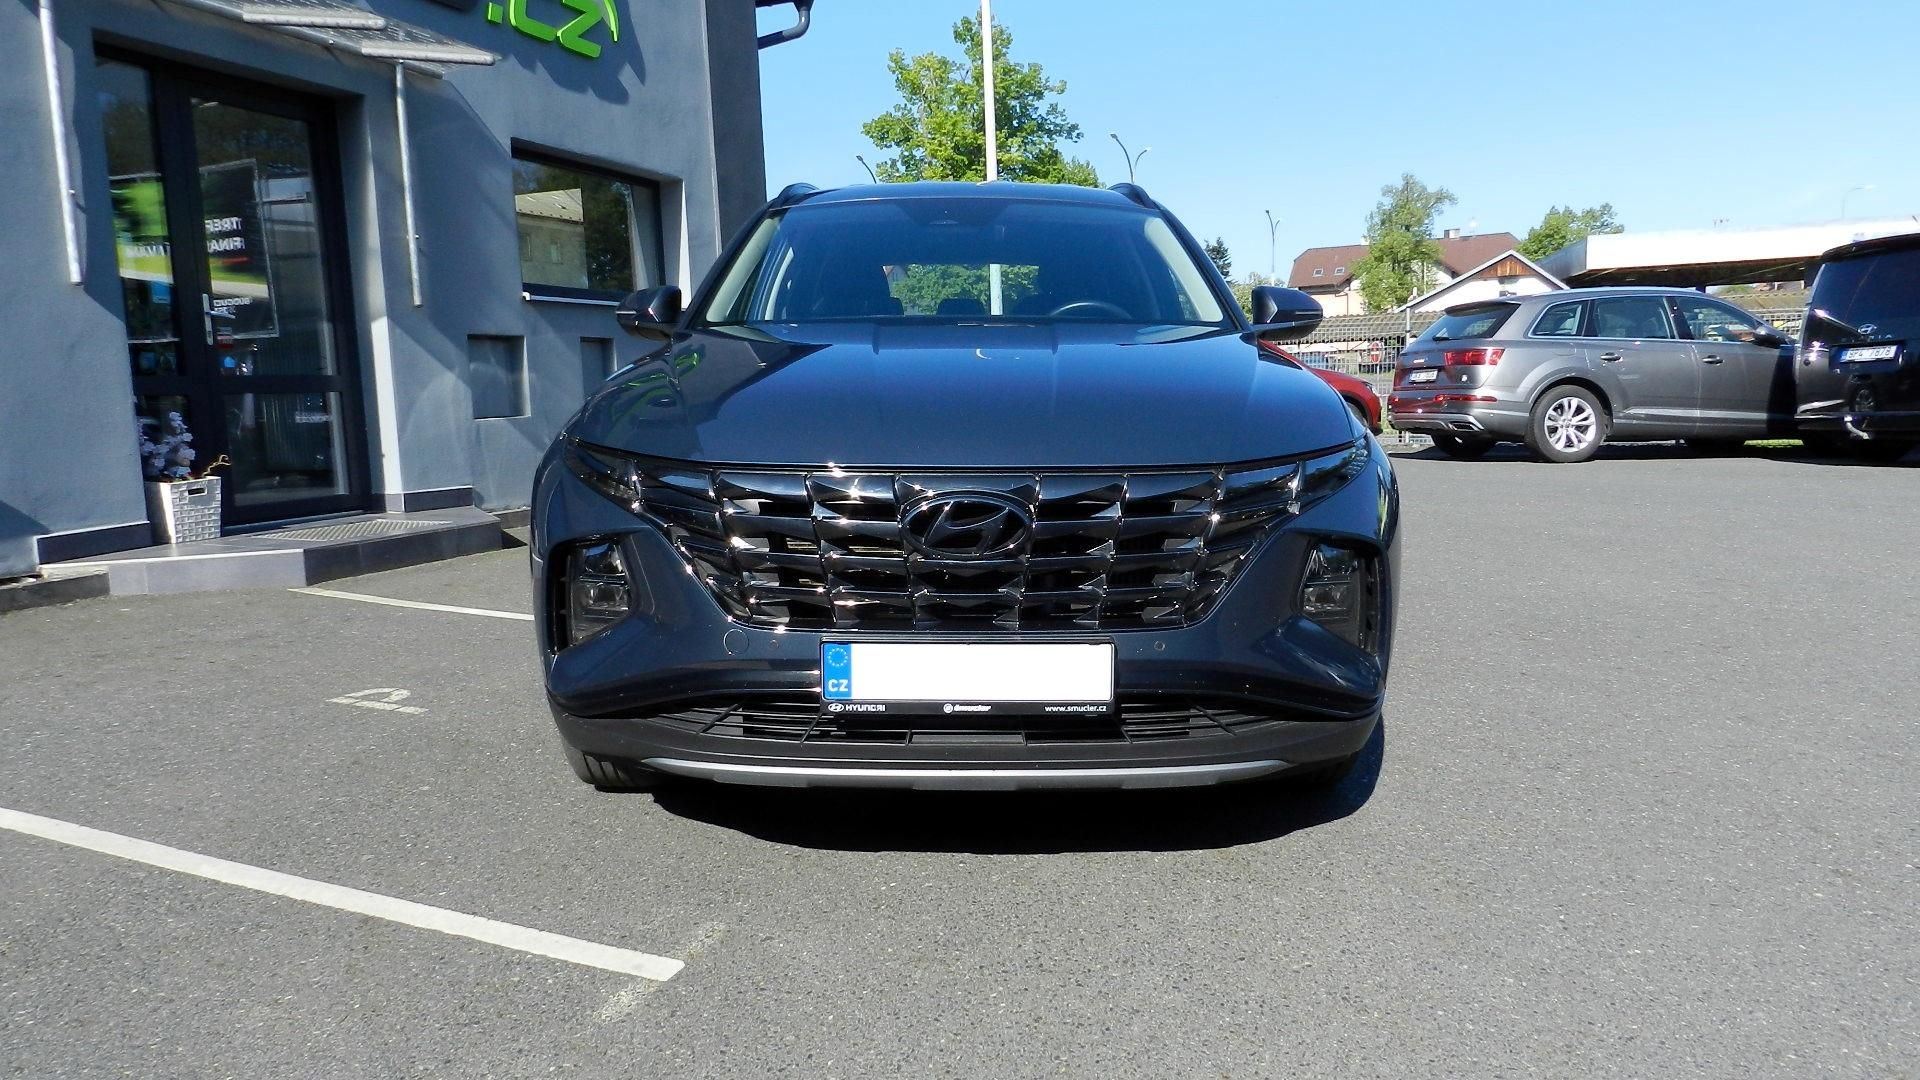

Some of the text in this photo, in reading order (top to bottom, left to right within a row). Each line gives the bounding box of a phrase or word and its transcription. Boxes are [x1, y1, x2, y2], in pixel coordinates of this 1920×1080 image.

[827, 679, 849, 693] CZ
[845, 704, 886, 712] HYUNDAI
[1044, 704, 1107, 713] www.smucler.cz
